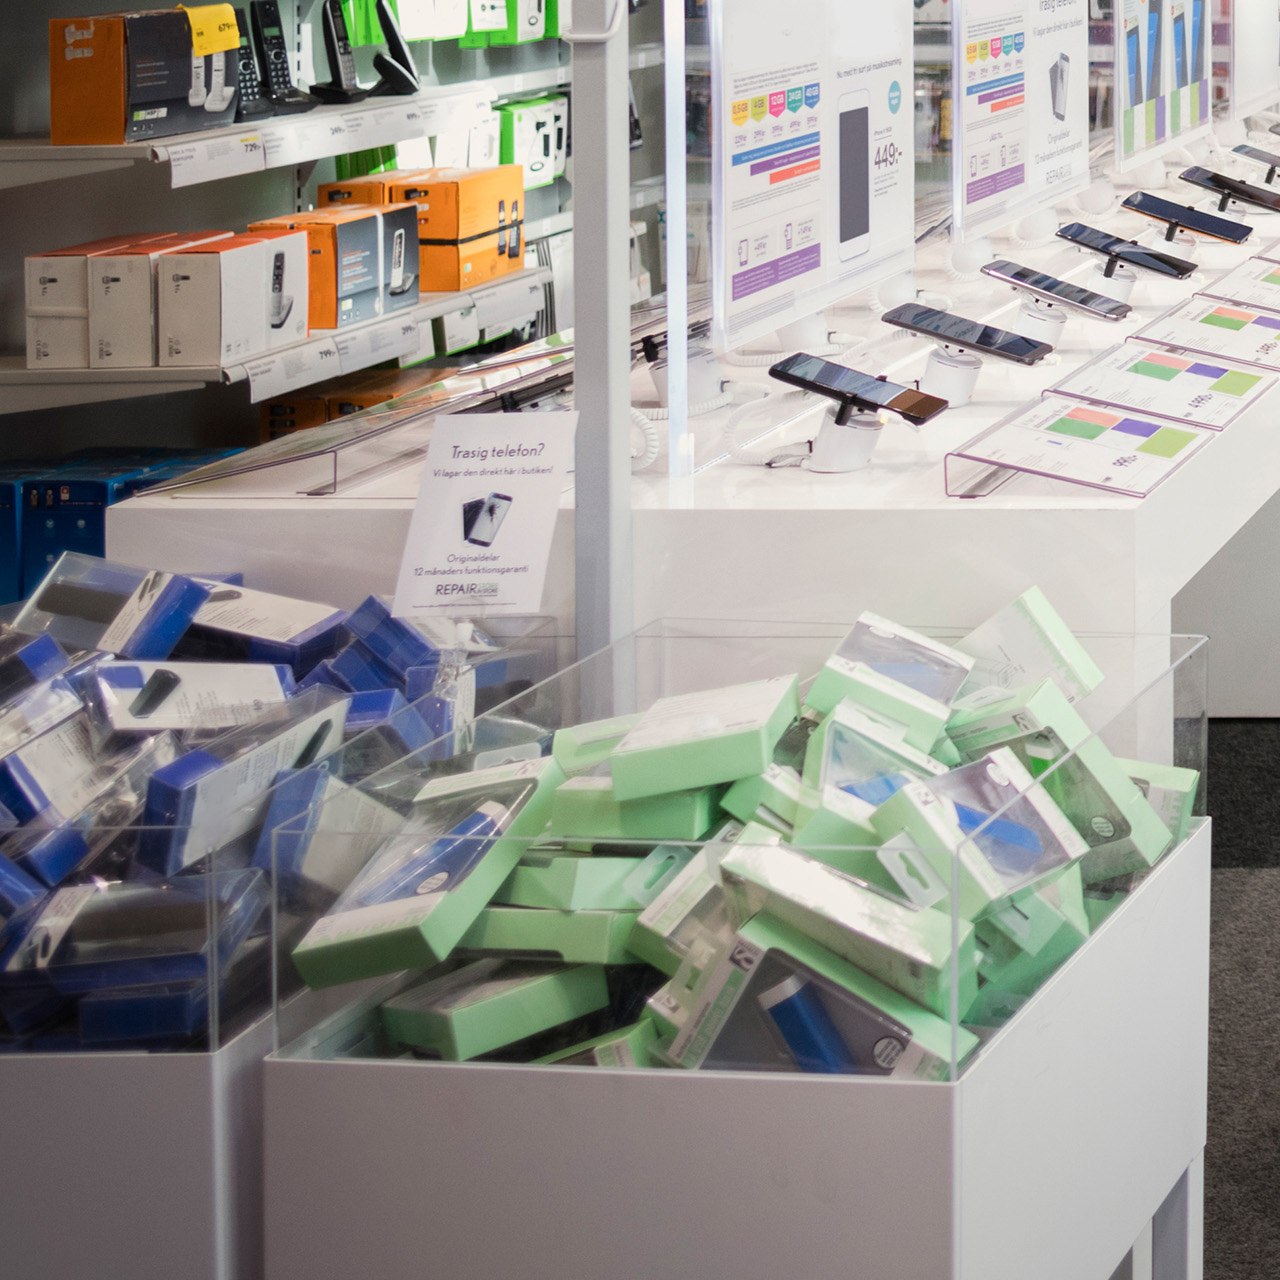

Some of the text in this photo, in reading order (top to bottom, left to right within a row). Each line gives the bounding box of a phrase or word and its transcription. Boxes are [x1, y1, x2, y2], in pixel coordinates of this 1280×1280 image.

[874, 142, 902, 170] 449:-
[452, 443, 544, 460] Trasig telefon?
[479, 467, 502, 475] direkt
[521, 466, 553, 474] butiken!
[447, 553, 499, 562] Originaldelar
[464, 566, 528, 574] funktionsgaranti
[435, 583, 481, 594] REPAIR
